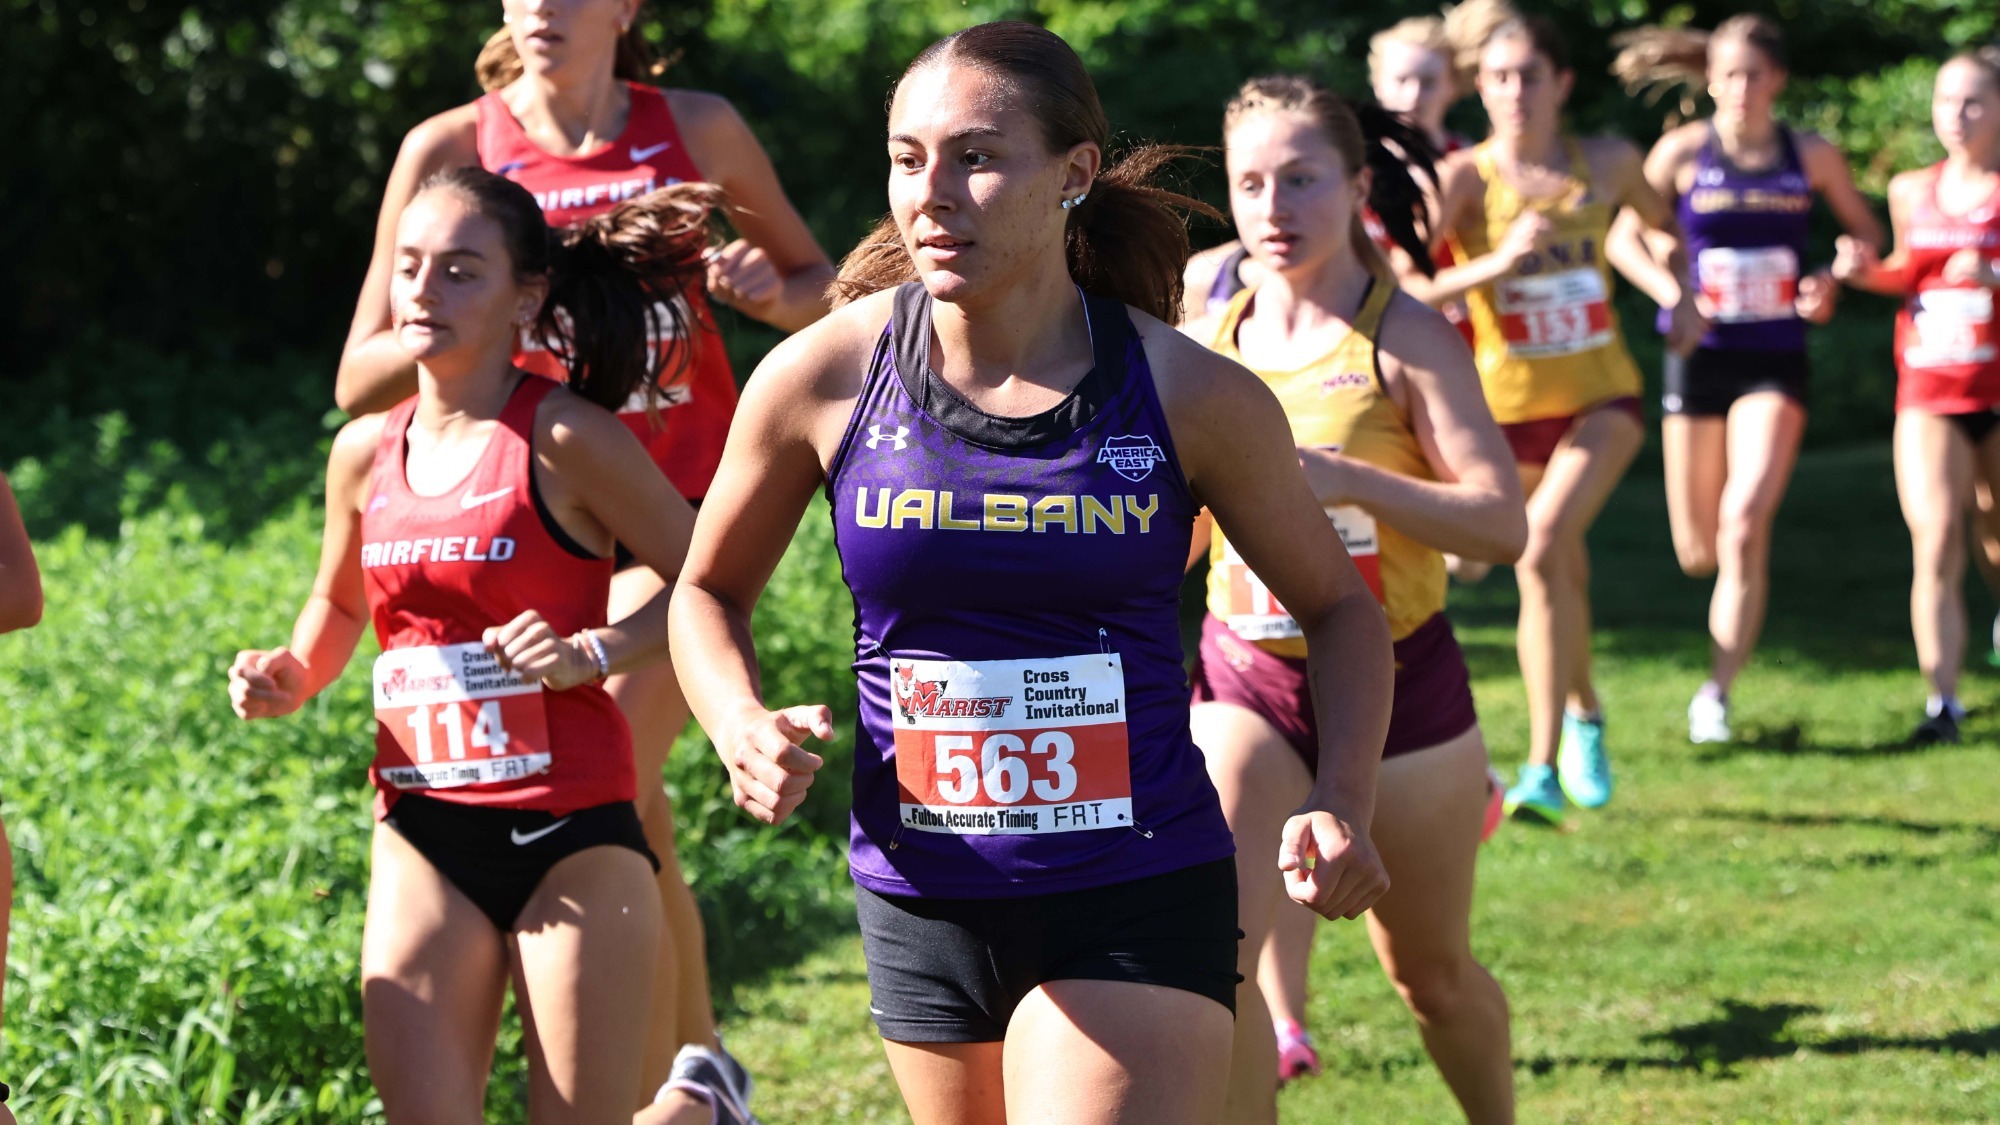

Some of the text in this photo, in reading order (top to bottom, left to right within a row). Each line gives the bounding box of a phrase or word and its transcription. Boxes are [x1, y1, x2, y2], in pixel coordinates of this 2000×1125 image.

[1099, 447, 1163, 461] AMERICA
[1114, 458, 1149, 468] EAST
[855, 486, 1159, 535] UALBANY
[1023, 669, 1070, 684] Cross
[908, 690, 1013, 718] MARIST
[1024, 687, 1087, 703] Country
[1025, 699, 1119, 719] Invitational
[406, 700, 510, 763] 114
[491, 757, 530, 777] FAT
[934, 731, 1078, 804] 563
[911, 802, 1103, 830] Fulton Accurate Timing FAT
